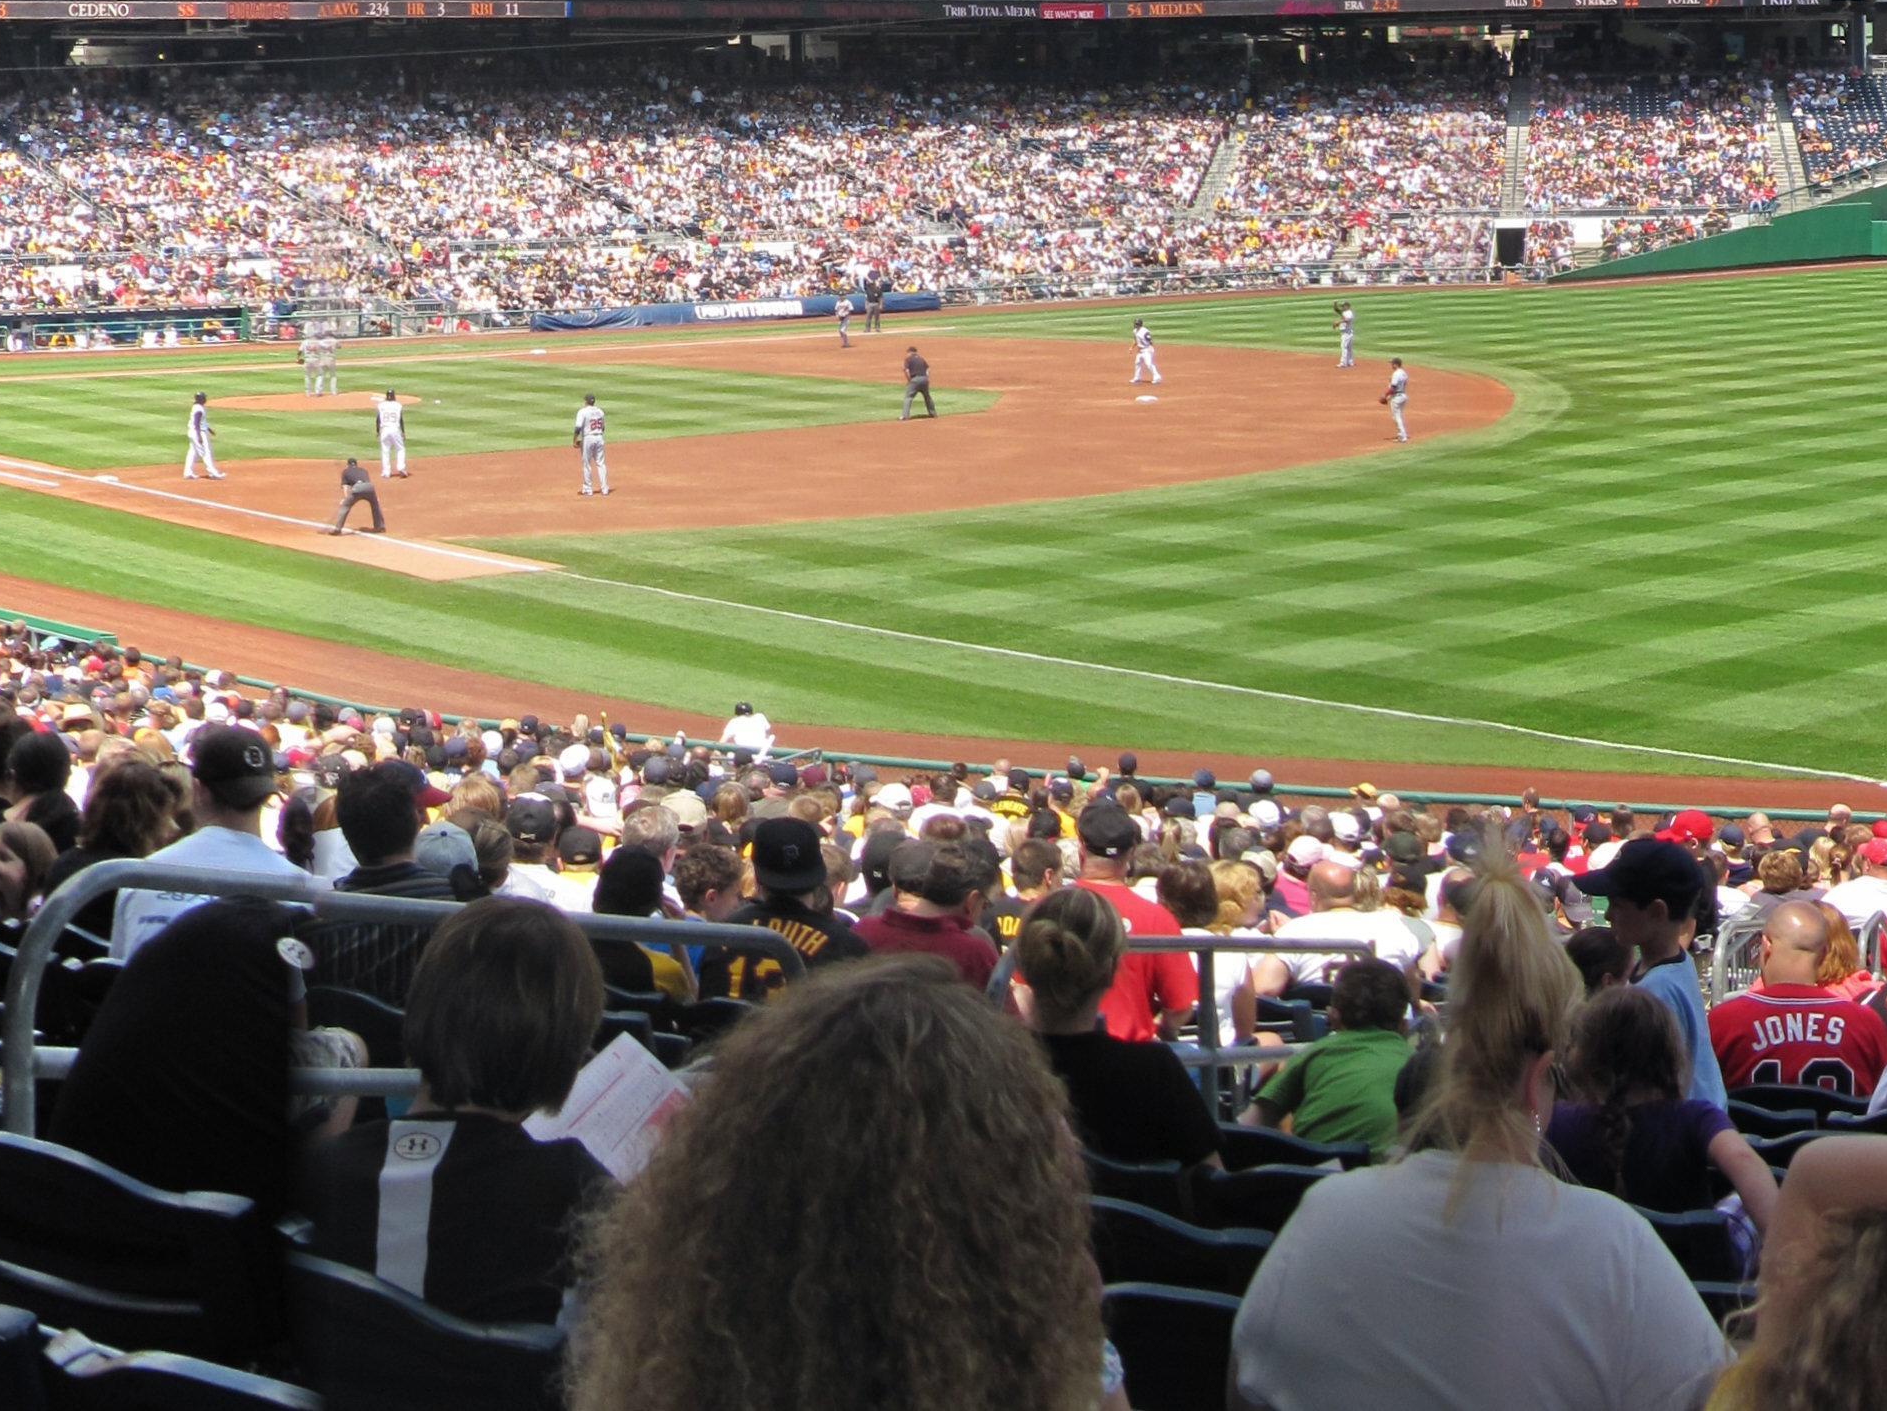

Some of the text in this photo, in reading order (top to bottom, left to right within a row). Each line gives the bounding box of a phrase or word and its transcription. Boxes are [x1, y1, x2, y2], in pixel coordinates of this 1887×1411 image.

[68, 3, 130, 17] CEDENO
[177, 3, 195, 17] SS
[407, 3, 425, 16] HR
[437, 3, 445, 16] 3
[471, 3, 493, 16] RBI
[505, 3, 519, 16] 11
[1149, 2, 1203, 16] MEDLEN
[1344, 0, 1363, 9] ERA
[1751, 1012, 1845, 1051] JONES
